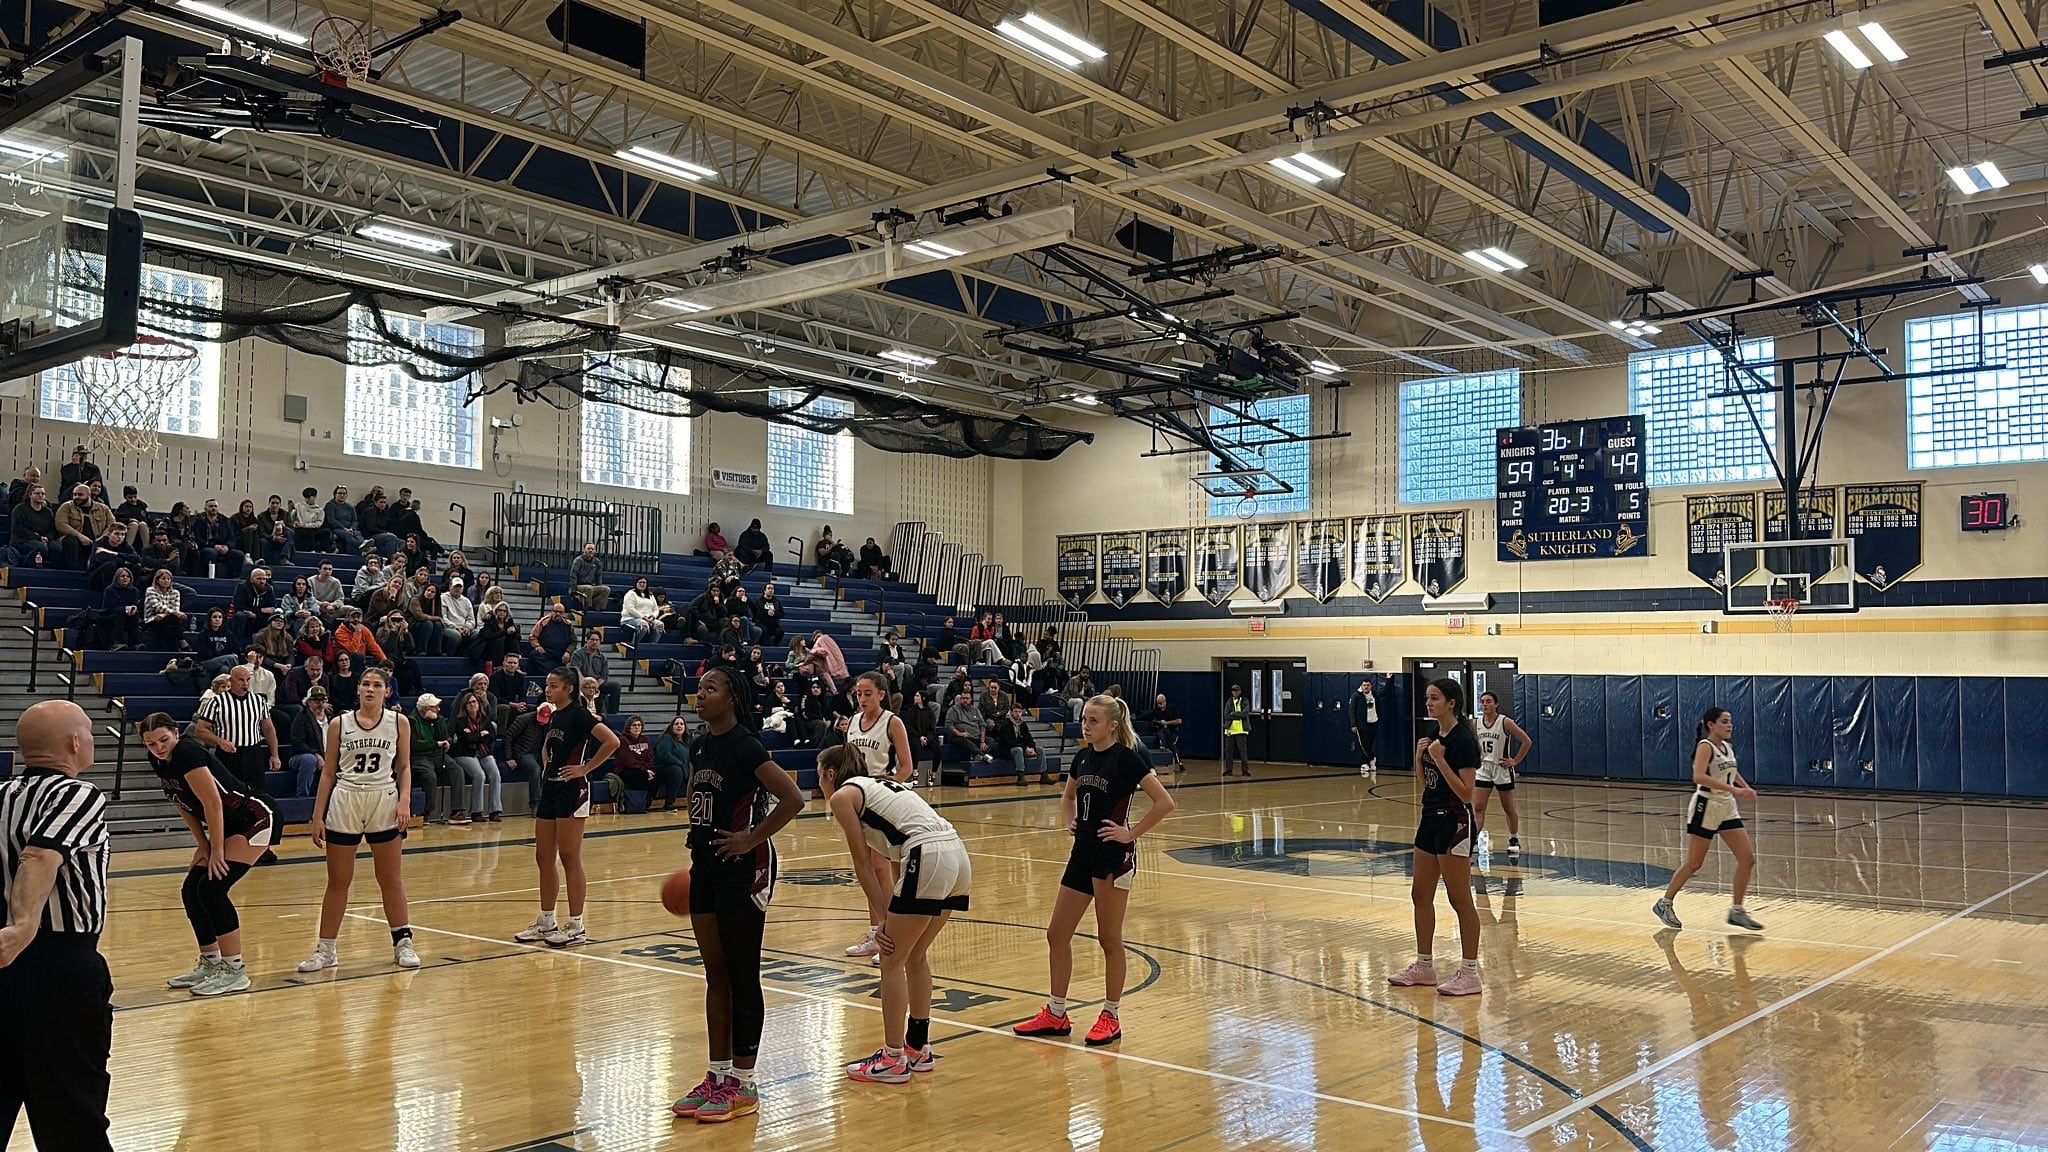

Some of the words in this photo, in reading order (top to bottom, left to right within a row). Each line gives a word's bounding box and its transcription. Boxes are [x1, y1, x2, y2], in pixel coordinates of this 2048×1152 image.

[1608, 437, 1636, 448] GUEST
[1501, 446, 1535, 458] KNIGHTS
[1564, 464, 1574, 478] 4
[1612, 453, 1638, 474] 49
[722, 472, 750, 483] VISITORS
[1508, 462, 1532, 484] 59
[1512, 500, 1522, 516] 2
[1630, 493, 1639, 509] 5
[1767, 497, 1833, 520] CHAPIONS
[1848, 493, 1919, 515] CHAMPIONS
[1690, 500, 1753, 524] CHAMPIONS
[1968, 500, 2001, 524] 30
[1413, 518, 1463, 538] CHAMPIONS
[1528, 529, 1612, 542] SUTHERLAND
[1060, 540, 1095, 557] CHAMPIONS
[1103, 538, 1140, 554] CHAMPIONS
[1540, 544, 1596, 555] KNIGHTS
[346, 739, 391, 751] SUTHERLAND
[1482, 741, 1493, 753] 15
[353, 753, 381, 773] 33
[691, 792, 713, 826] 20
[1083, 793, 1090, 820] 1
[909, 859, 917, 873] S
